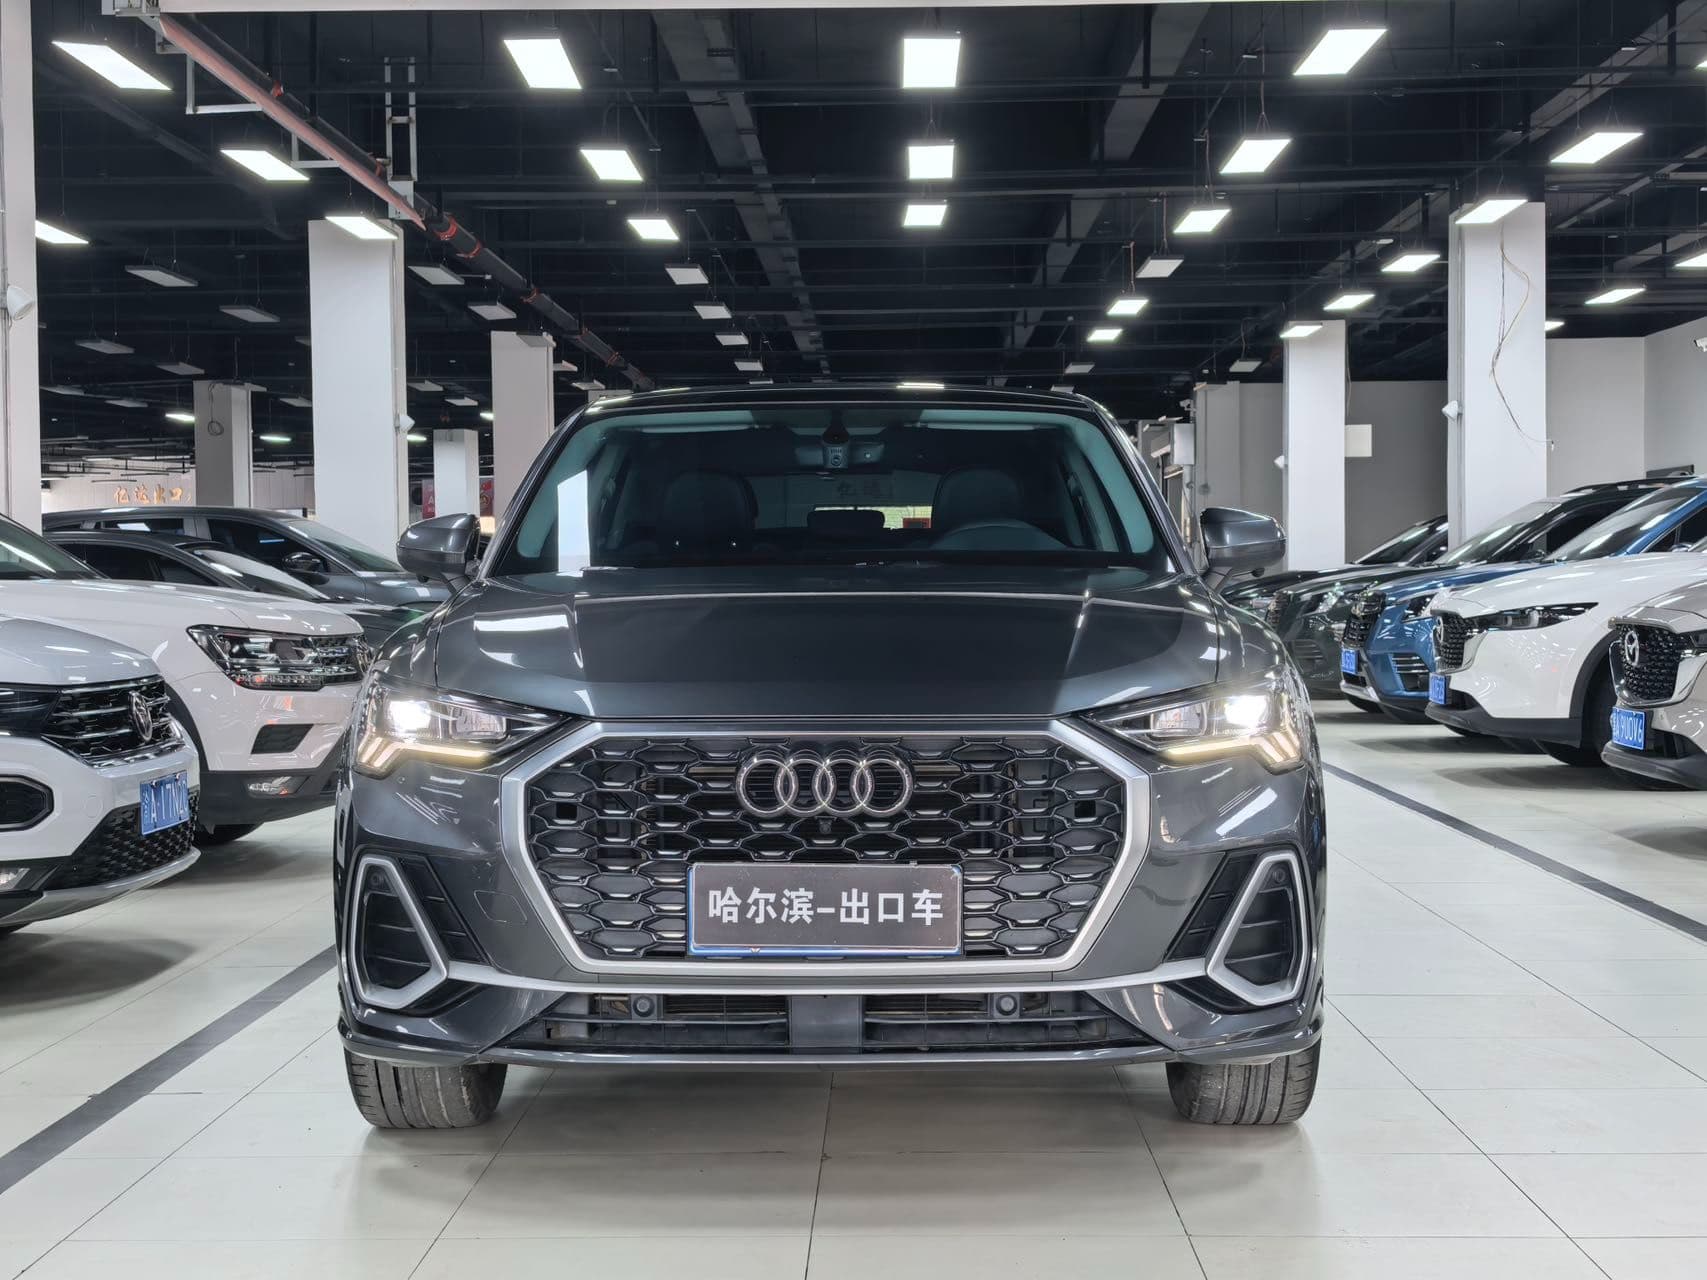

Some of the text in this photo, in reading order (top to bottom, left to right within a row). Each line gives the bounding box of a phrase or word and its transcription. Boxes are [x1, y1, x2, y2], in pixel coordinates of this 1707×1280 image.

[708, 886, 944, 926] 哈尔滨-出口车
